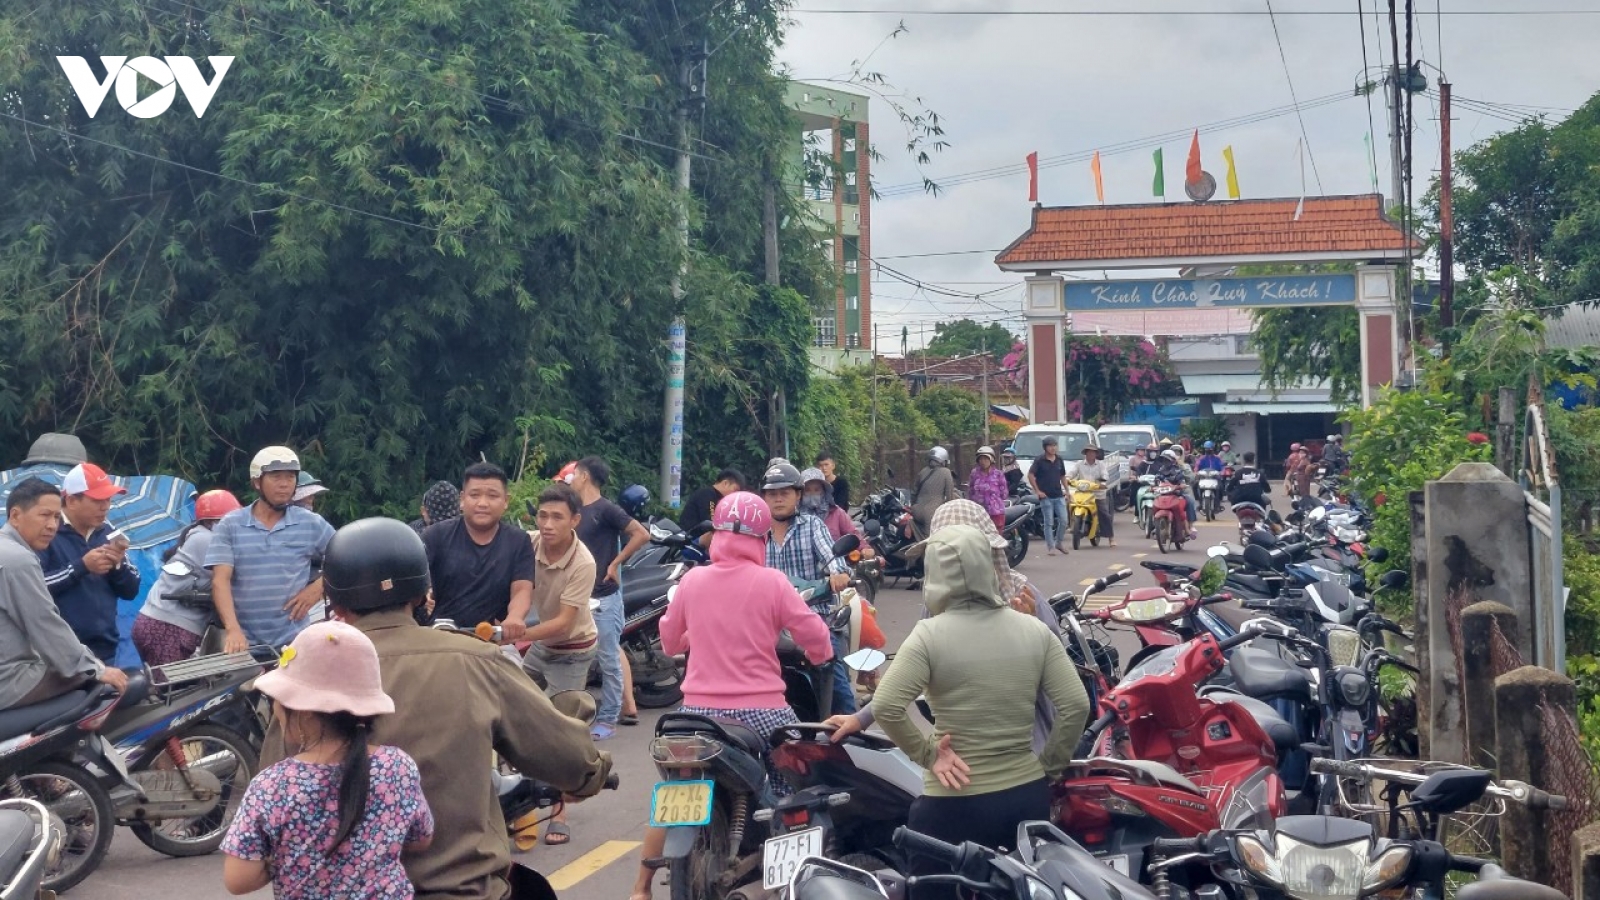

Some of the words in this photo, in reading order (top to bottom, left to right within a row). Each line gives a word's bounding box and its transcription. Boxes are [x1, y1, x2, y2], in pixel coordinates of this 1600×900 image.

[1152, 282, 1198, 304] Chào
[662, 784, 703, 804] 77-X4
[659, 804, 702, 823] 2036
[773, 833, 811, 863] 77-F1
